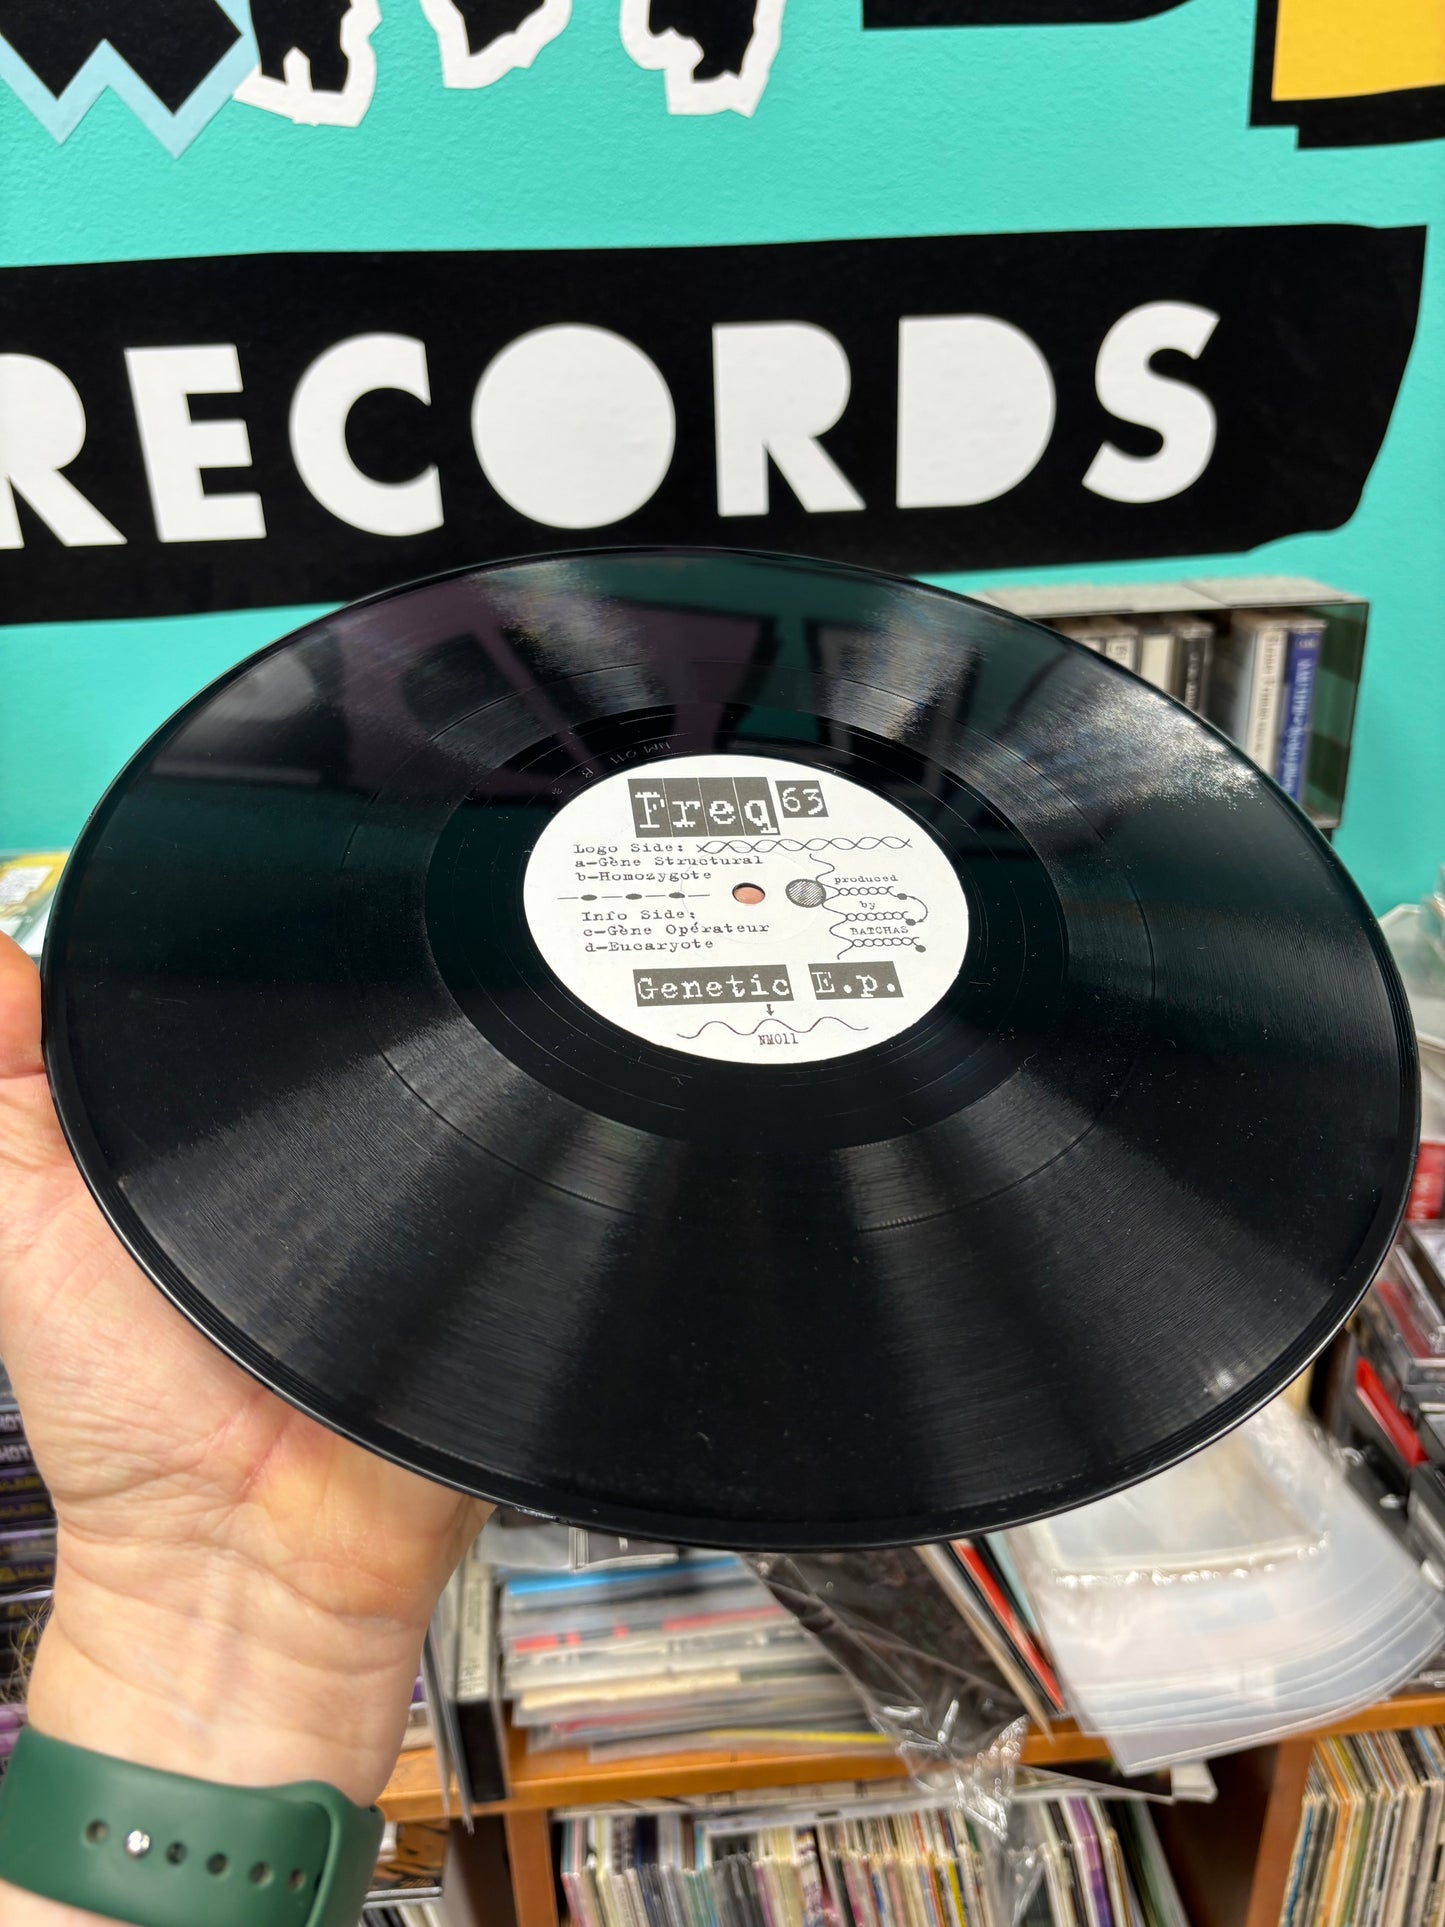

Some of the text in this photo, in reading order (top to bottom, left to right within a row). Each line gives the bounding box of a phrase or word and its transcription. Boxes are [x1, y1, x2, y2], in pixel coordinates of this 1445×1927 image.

[0, 301, 1220, 549] RECORDS
[635, 787, 824, 834] Freq 63
[573, 843, 683, 855] Logo Side:
[654, 856, 764, 866] Structural
[576, 870, 711, 882] b-Homozygote
[834, 875, 898, 885] produced
[859, 901, 875, 910] by
[582, 909, 696, 921] Info Side:
[665, 922, 770, 936] Opérateur
[850, 926, 909, 935] BATCHAS
[585, 939, 713, 953] d-Eucaryote
[638, 971, 896, 999] Genetic E.p.
